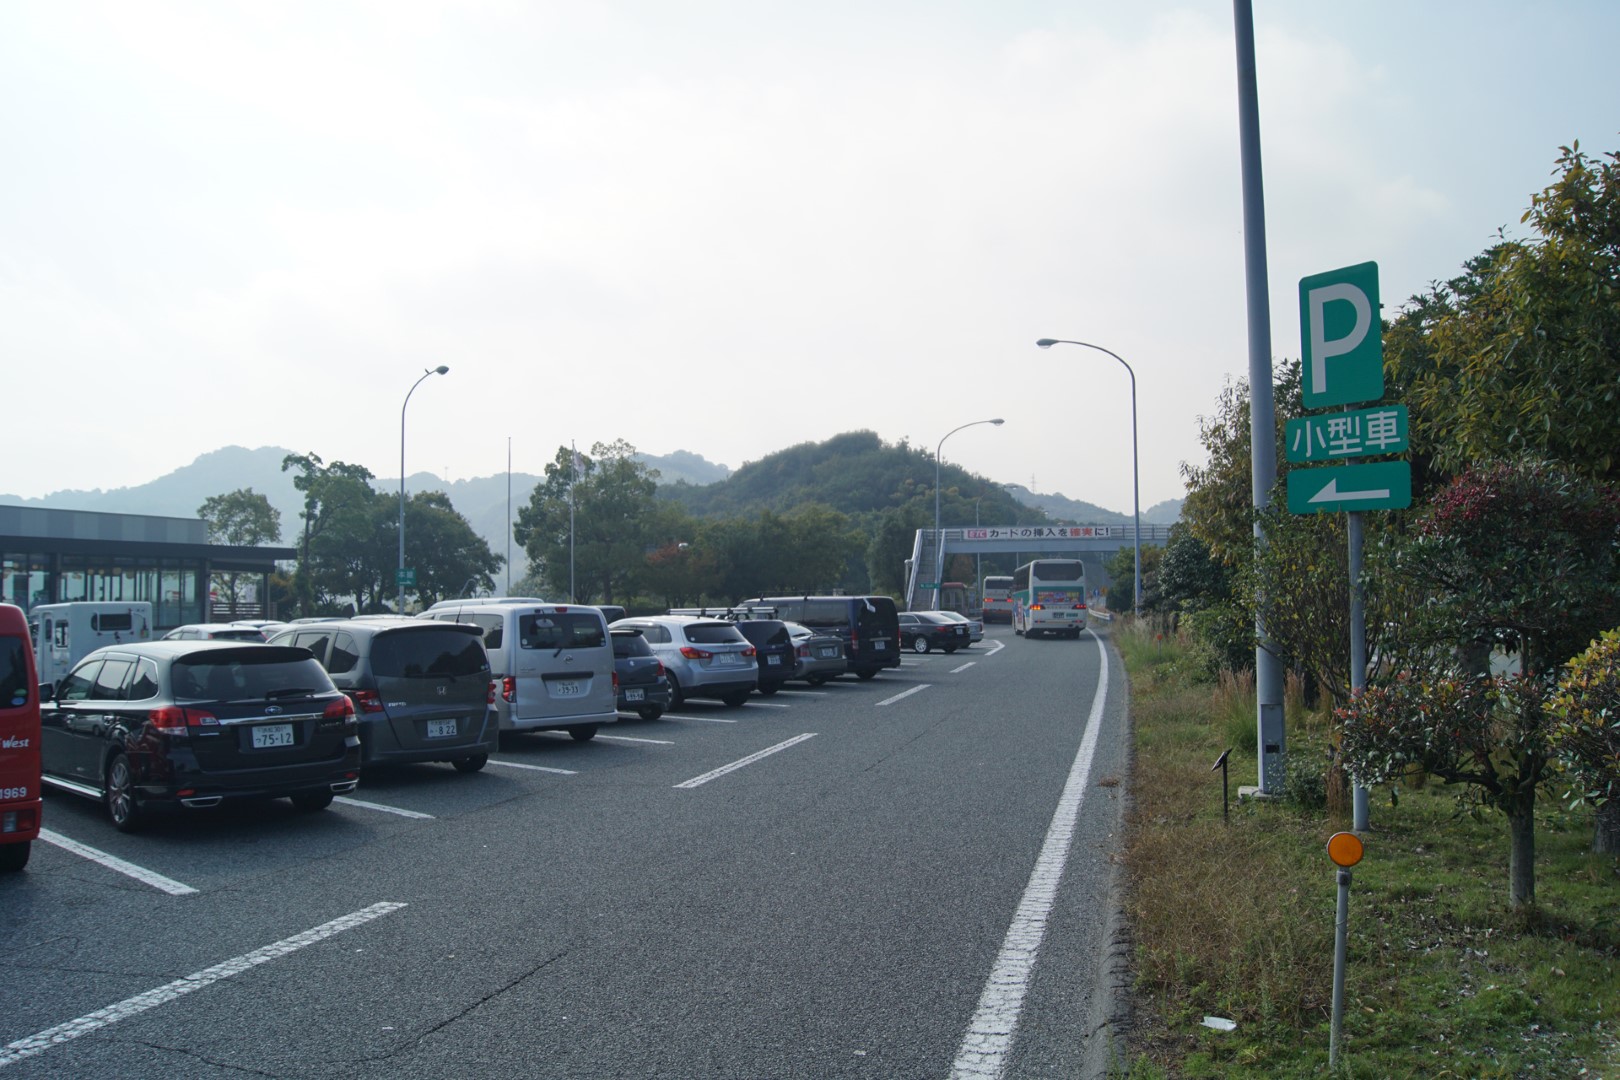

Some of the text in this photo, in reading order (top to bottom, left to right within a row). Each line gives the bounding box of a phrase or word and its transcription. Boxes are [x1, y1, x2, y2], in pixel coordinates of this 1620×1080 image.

[1309, 283, 1371, 394] P
[1293, 411, 1400, 457] 小型車
[3, 736, 29, 748] West
[262, 733, 292, 745] 75-12
